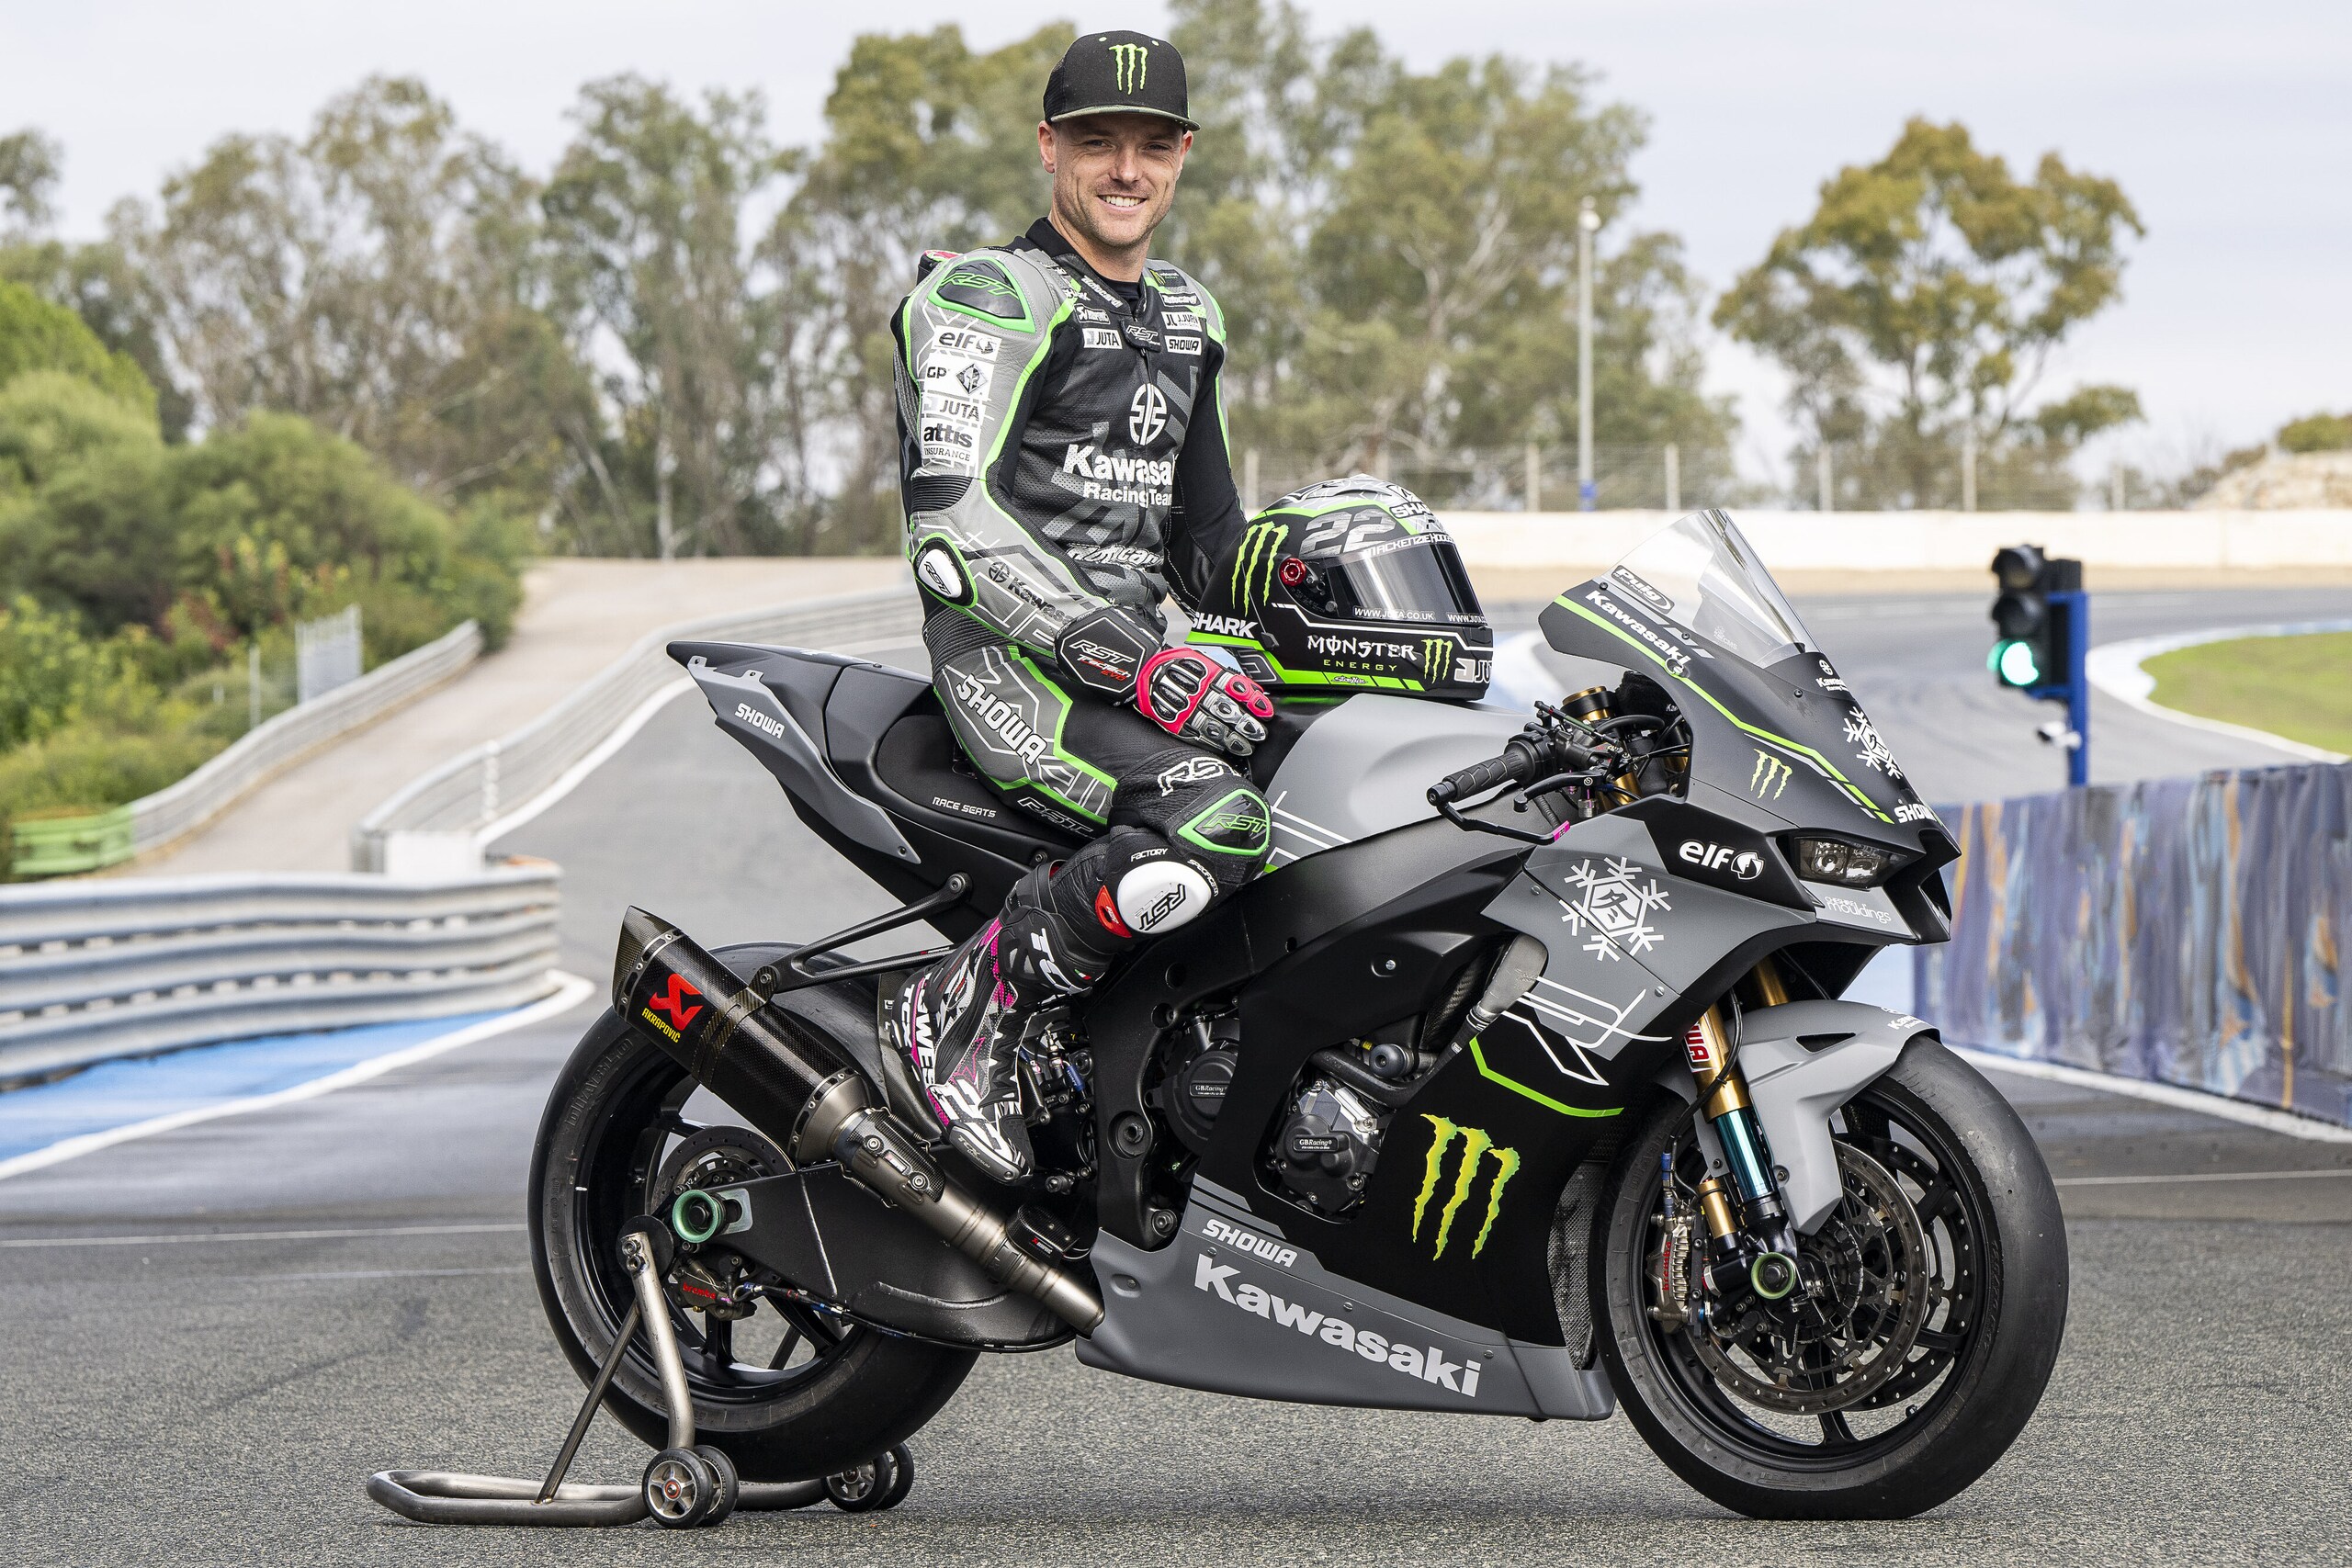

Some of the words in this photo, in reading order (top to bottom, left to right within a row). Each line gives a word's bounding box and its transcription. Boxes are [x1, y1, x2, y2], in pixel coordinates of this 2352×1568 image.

[939, 272, 1020, 299] RST
[939, 332, 976, 349] elf
[1096, 329, 1120, 346] JUTA
[1126, 325, 1158, 341] RST
[1169, 338, 1200, 352] SHOWA
[926, 366, 947, 379] GP
[940, 400, 979, 422] JUTA
[923, 423, 973, 448] attis
[924, 447, 971, 462] INSURANCE
[1063, 444, 1177, 486] Kawasa
[1299, 508, 1396, 558] 22
[924, 561, 951, 595] RST
[1614, 568, 1663, 601] Puig
[1586, 591, 1691, 672] Kawasaki
[1069, 639, 1136, 664] RST
[1323, 659, 1397, 671] ENERGY
[735, 702, 786, 739] SHOWA
[956, 673, 1048, 766] SHOWA
[932, 796, 960, 811] RACE
[961, 804, 997, 818] SEATS
[1017, 796, 1094, 834] RST
[1202, 812, 1268, 833] RST
[1678, 839, 1736, 870] elf
[1138, 883, 1187, 931] RST
[1826, 900, 1892, 924] mouldings
[901, 984, 914, 1049] TCX
[958, 1135, 981, 1160] TCX
[1202, 1219, 1298, 1268] SHOWA
[1662, 1241, 1671, 1291] brembo
[683, 1282, 716, 1300] brembo
[1194, 1253, 1482, 1397] Kawasaki
